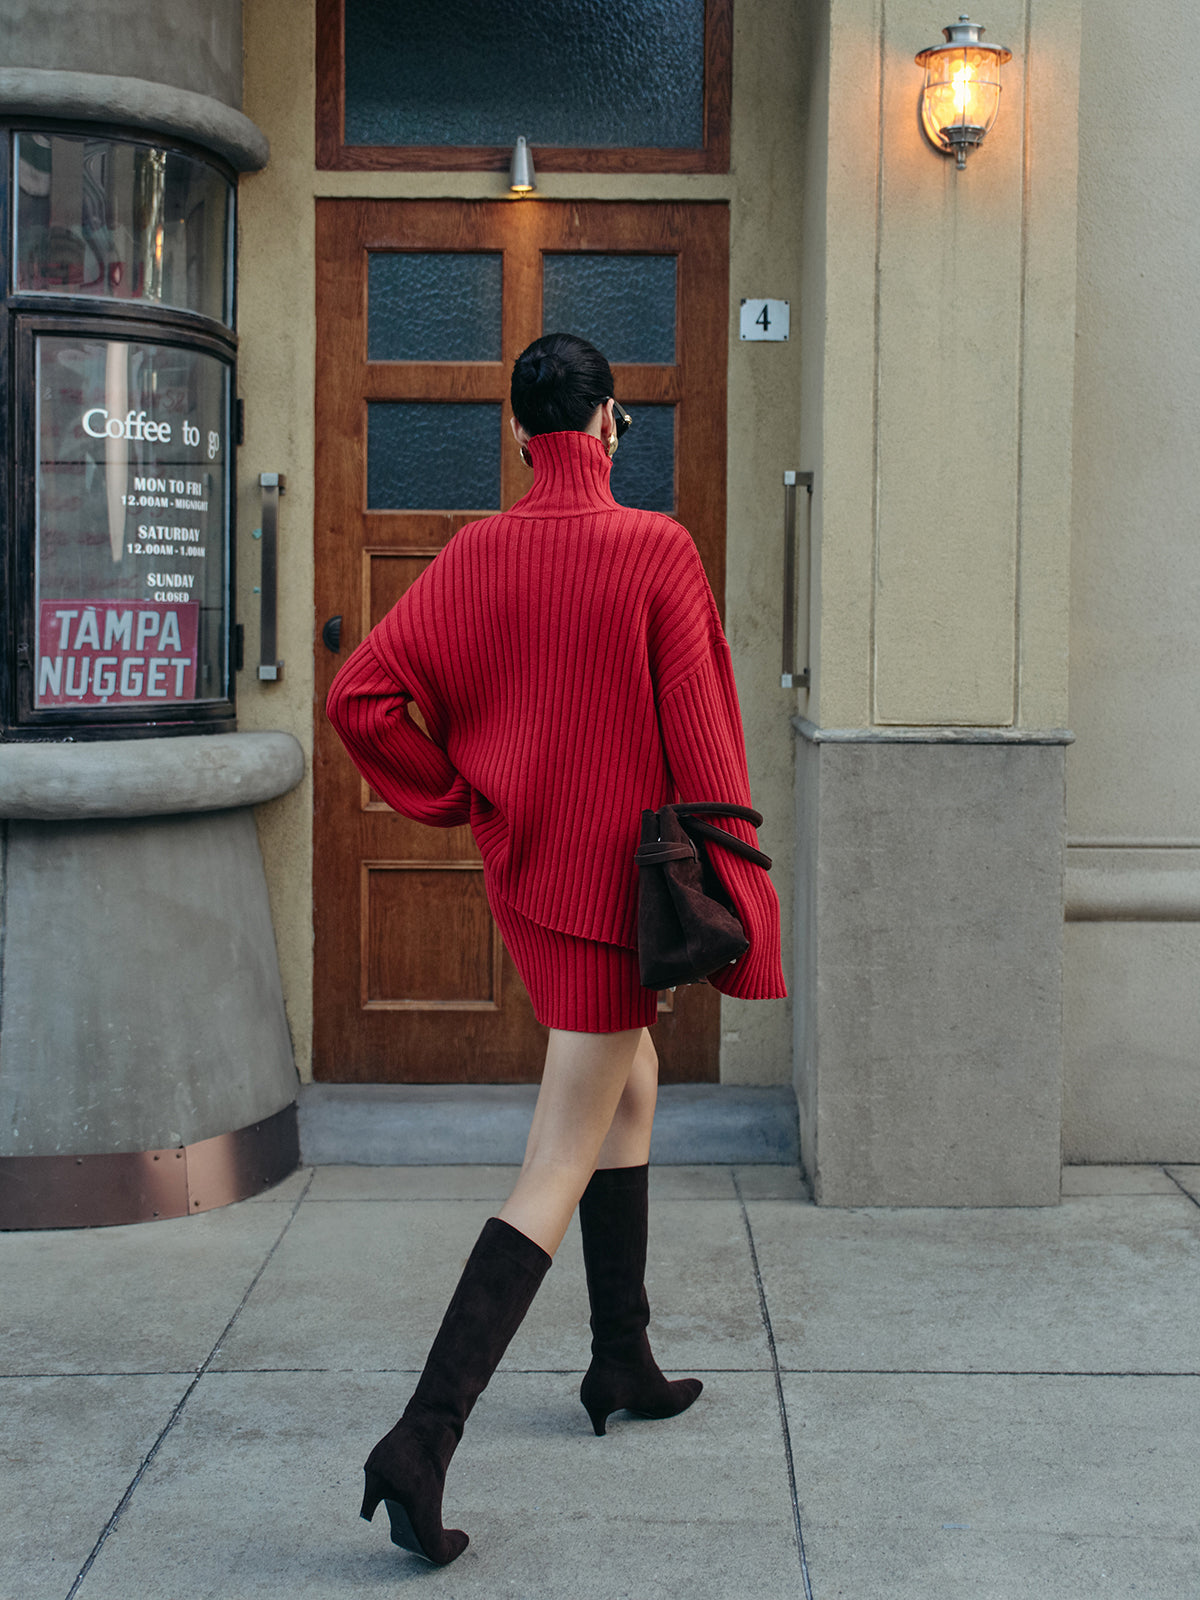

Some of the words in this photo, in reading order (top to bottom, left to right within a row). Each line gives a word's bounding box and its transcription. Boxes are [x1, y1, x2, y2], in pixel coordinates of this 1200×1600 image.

[755, 304, 771, 331] 4
[82, 408, 171, 443] Coffee
[182, 420, 200, 447] to
[208, 430, 219, 459] go
[134, 477, 166, 493] MON
[169, 479, 184, 494] TO
[186, 481, 202, 496] FRI
[121, 495, 169, 508] 12.00AM
[138, 525, 200, 542] SATURDAY
[127, 543, 174, 555] 12.00AM
[147, 573, 195, 588] SUNDAY
[154, 591, 190, 603] CLOSED
[56, 610, 182, 651] TAMPA
[39, 656, 191, 697] NUGGET
